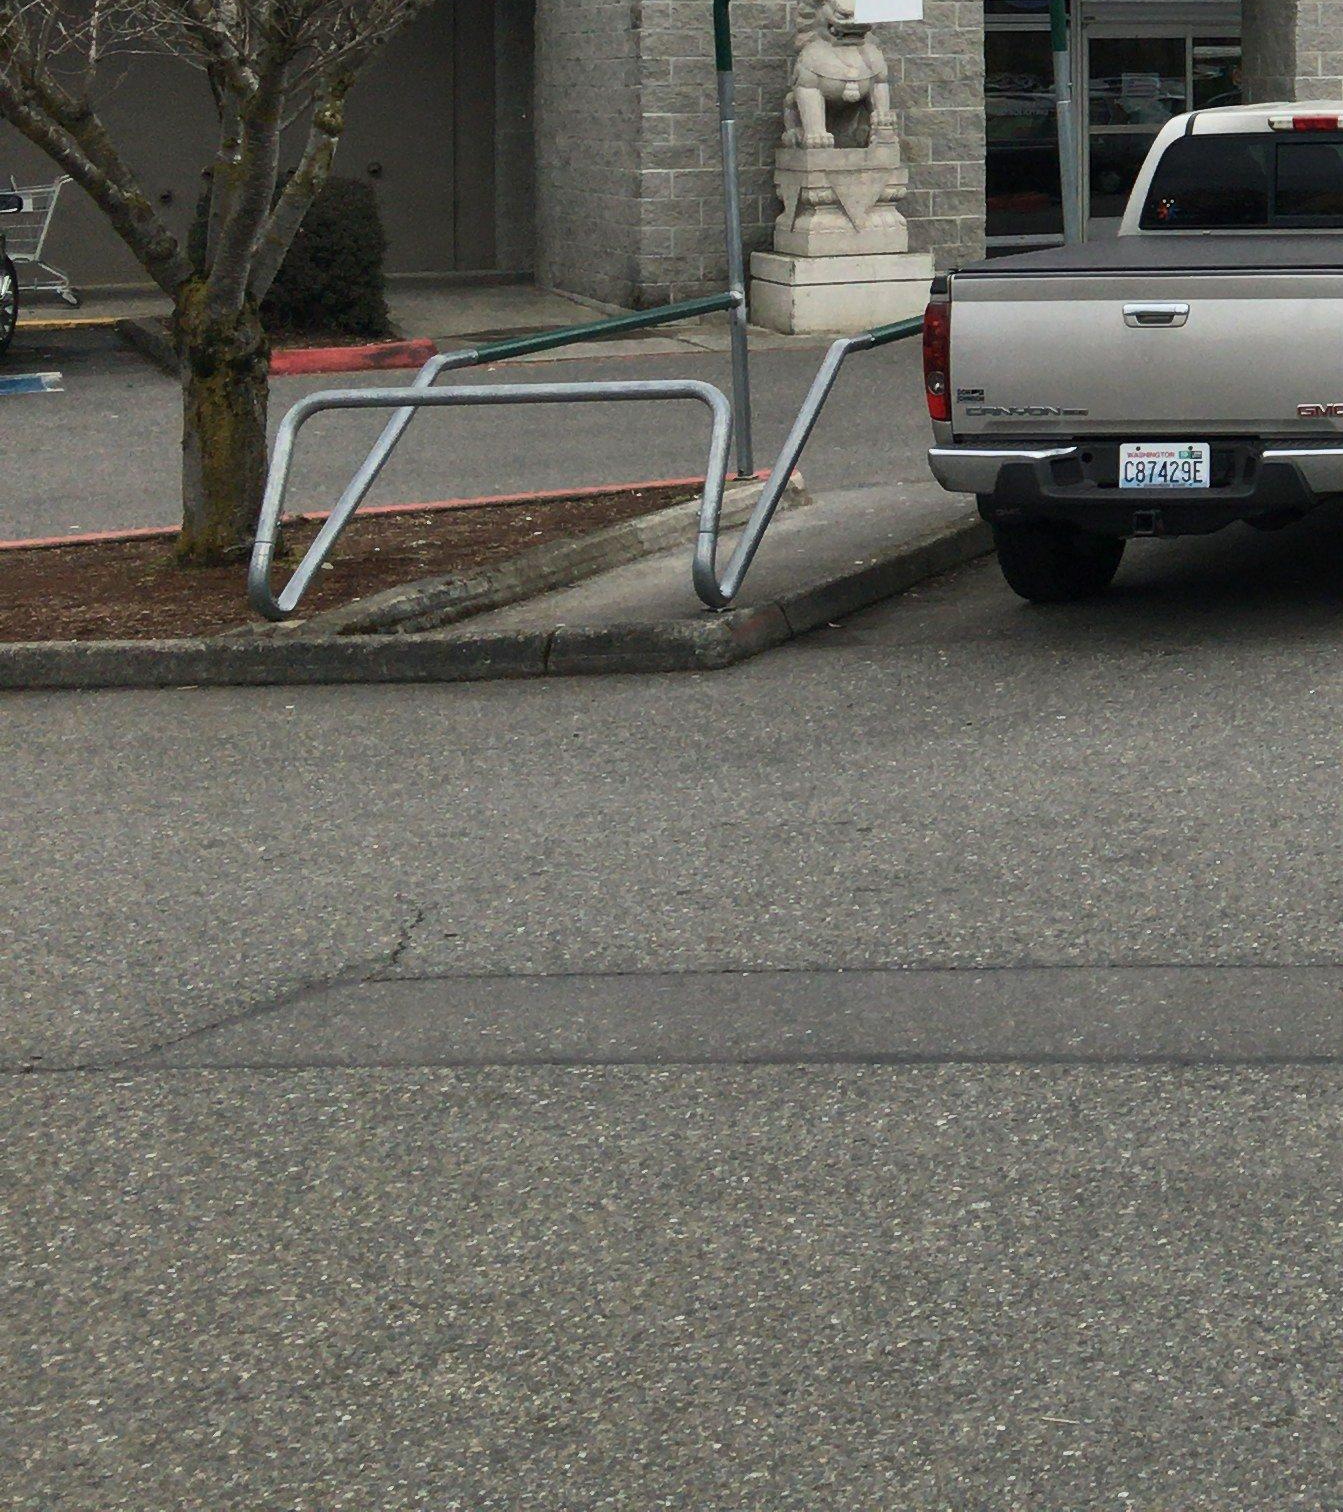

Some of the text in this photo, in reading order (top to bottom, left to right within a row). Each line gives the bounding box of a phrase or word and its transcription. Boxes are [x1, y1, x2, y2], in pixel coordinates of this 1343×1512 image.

[965, 406, 1060, 417] CANYON
[1126, 450, 1176, 459] WASHINGTON
[1124, 460, 1204, 484] C87429E
